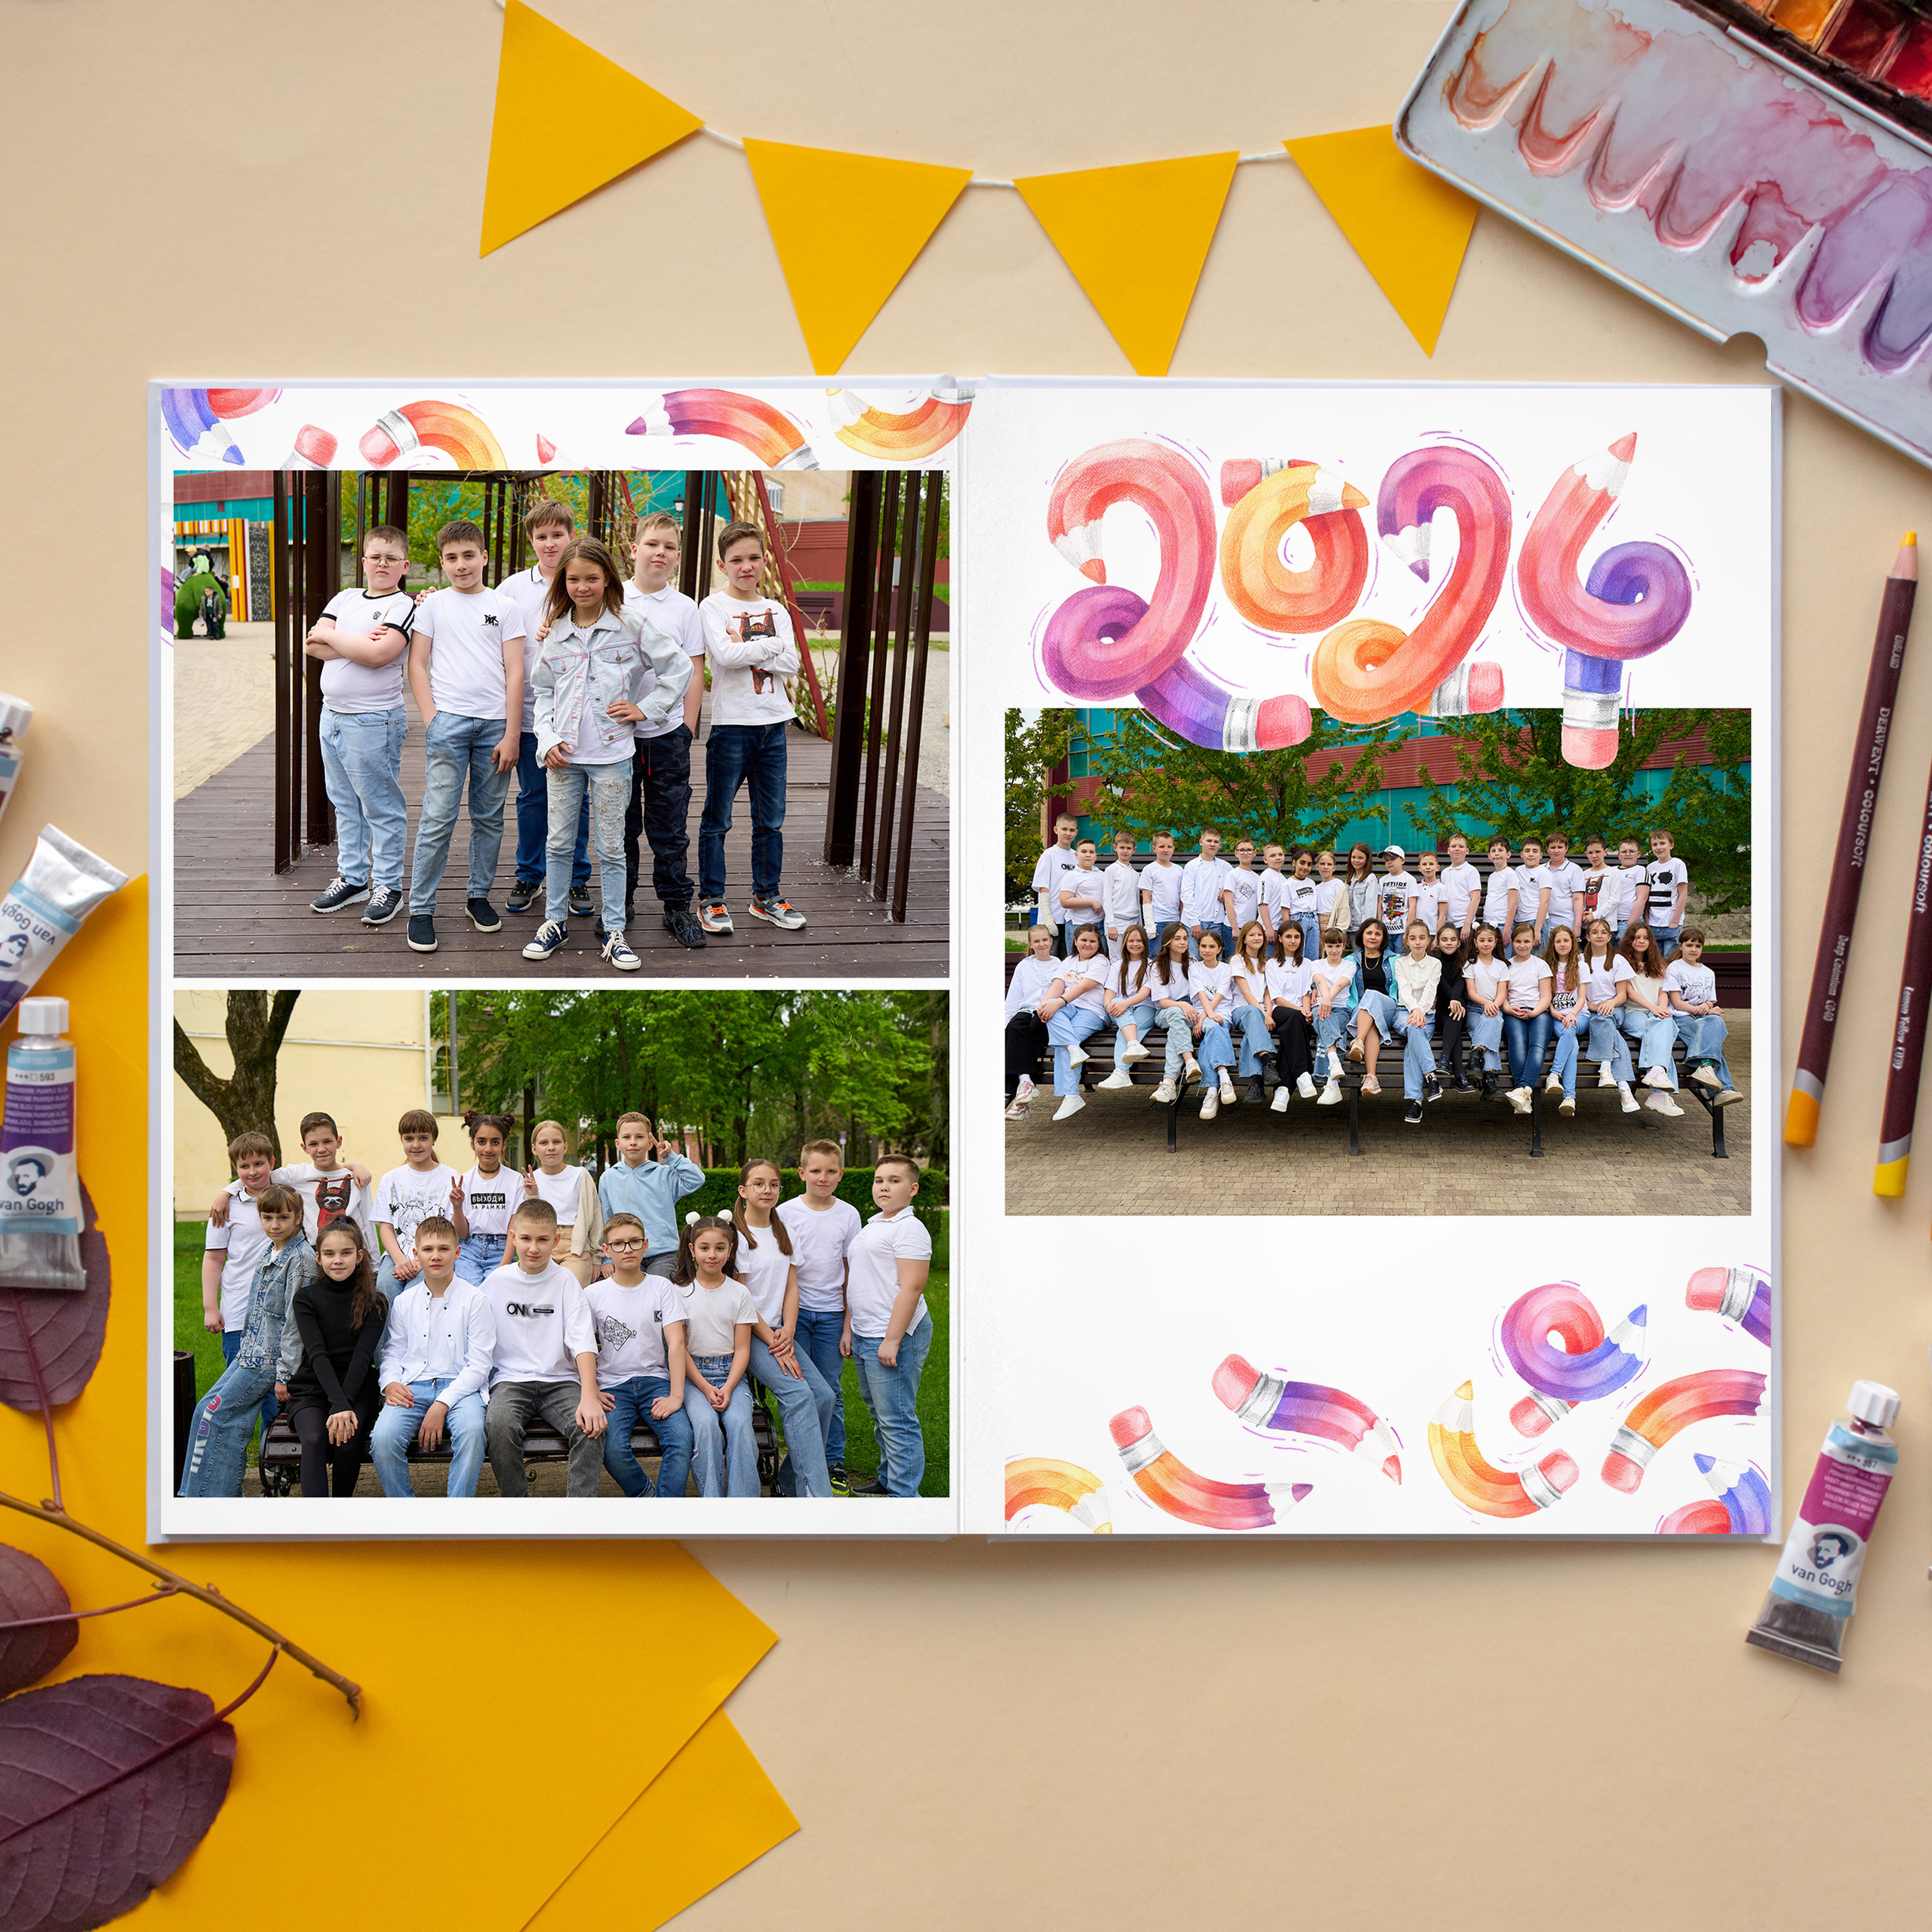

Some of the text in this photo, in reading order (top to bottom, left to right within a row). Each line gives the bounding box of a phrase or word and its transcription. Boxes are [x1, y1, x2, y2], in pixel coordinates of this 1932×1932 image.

[1851, 707, 1890, 868] DERWENT coloursoft
[1914, 835, 1932, 913] coloursoft
[2, 903, 57, 945] van Gogh
[1833, 935, 1848, 956] Deep
[1828, 958, 1844, 995] Cadmium
[1900, 986, 1915, 1014] Lemon
[1897, 1017, 1910, 1043] Yellow
[40, 1072, 55, 1081] 593
[27, 1198, 64, 1215] Gogh
[1792, 1564, 1853, 1595] van Gogh
